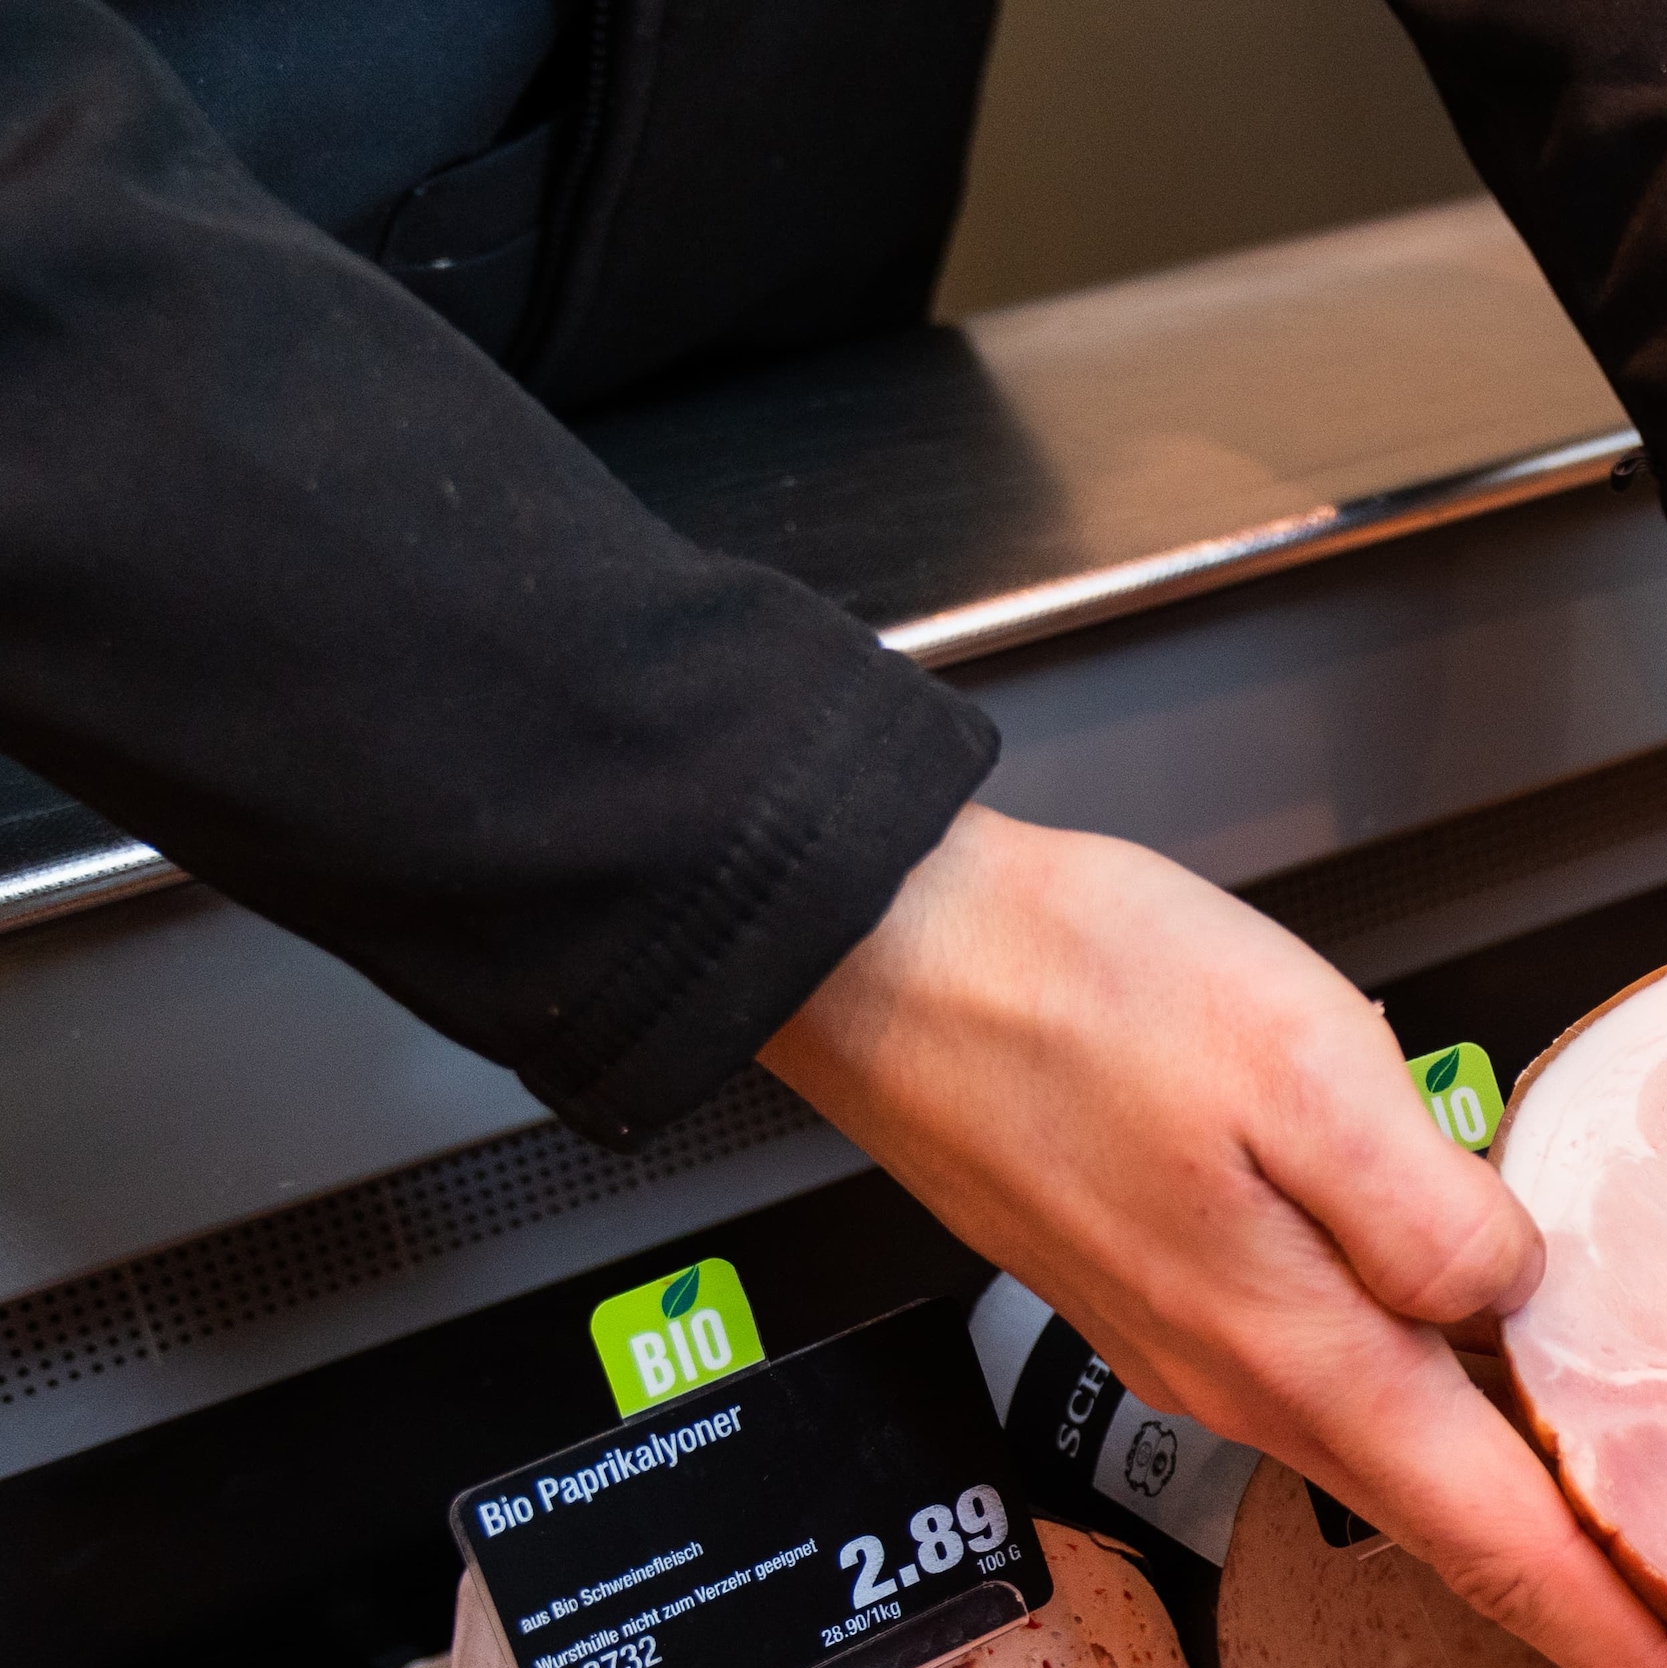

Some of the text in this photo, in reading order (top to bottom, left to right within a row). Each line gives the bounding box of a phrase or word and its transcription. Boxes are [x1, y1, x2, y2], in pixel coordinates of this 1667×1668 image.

[630, 1308, 733, 1398] BIO
[476, 1404, 743, 1538] Bio Paprikalyoner
[520, 1540, 705, 1634] aus Bio Schweinefleisch
[621, 1608, 662, 1637] nicht
[662, 1595, 696, 1619] zum
[697, 1568, 754, 1605] Verzehr
[754, 1537, 819, 1583] geeignet
[839, 1484, 1009, 1611] 2.89
[976, 1544, 1022, 1576] 100 G
[821, 1599, 902, 1649] 28.90/1kg
